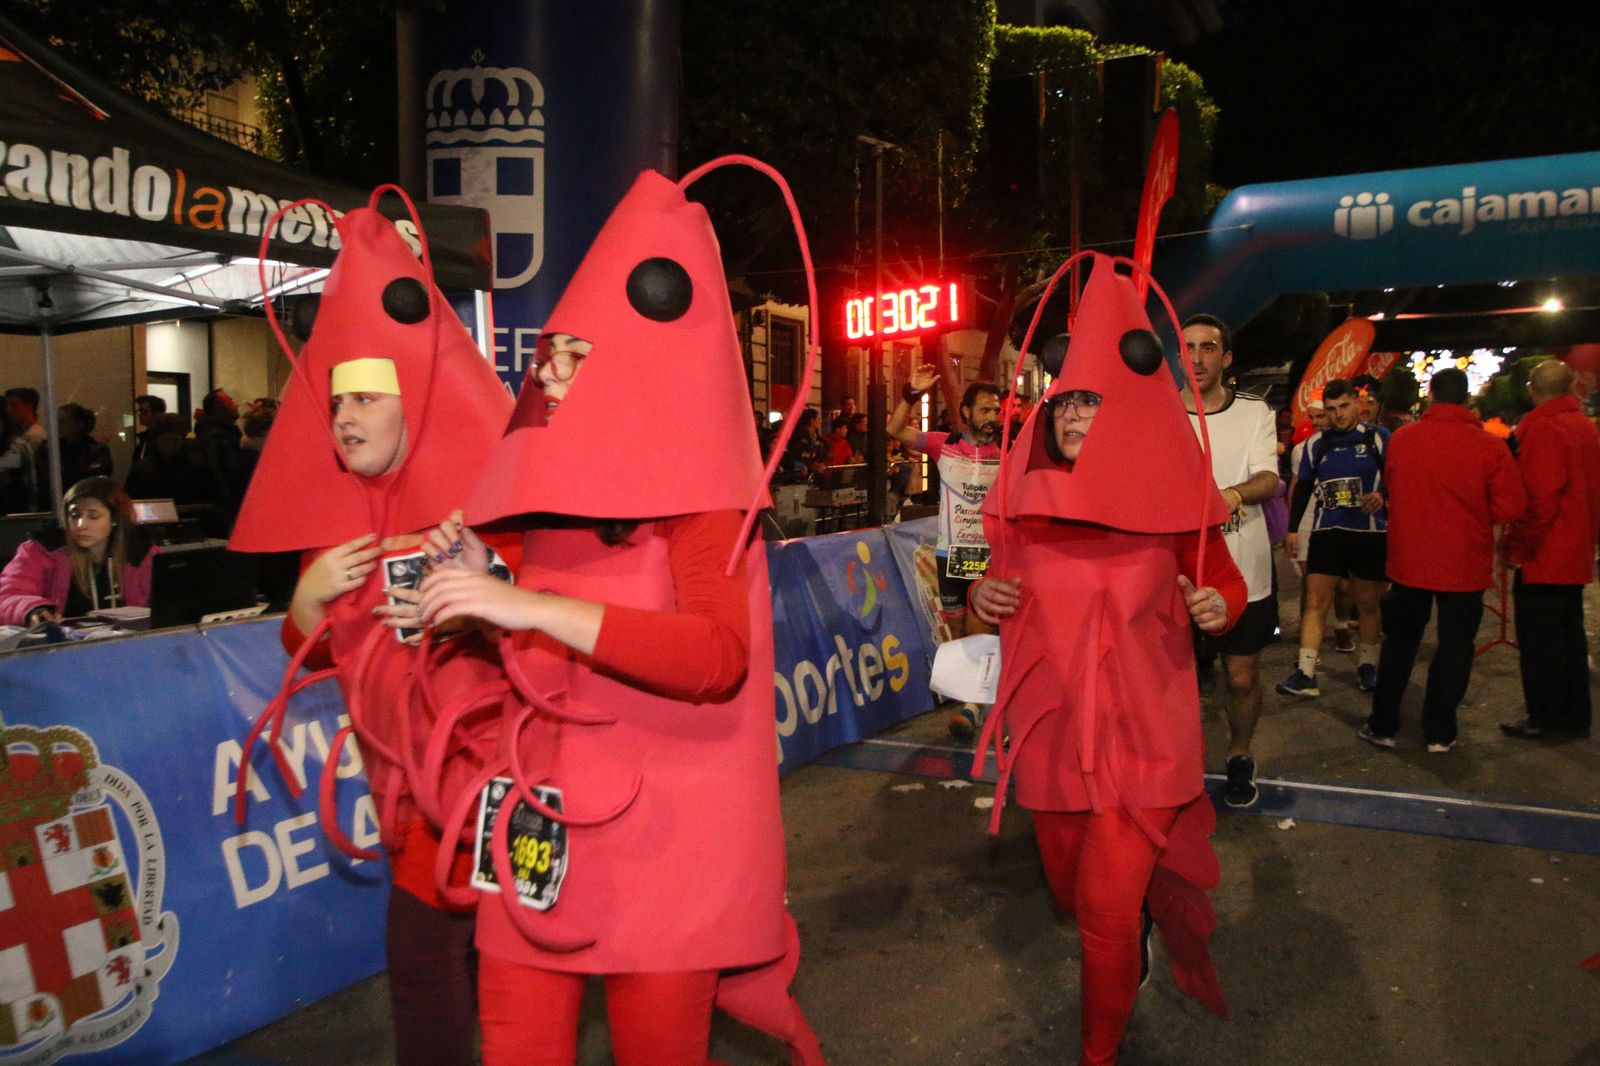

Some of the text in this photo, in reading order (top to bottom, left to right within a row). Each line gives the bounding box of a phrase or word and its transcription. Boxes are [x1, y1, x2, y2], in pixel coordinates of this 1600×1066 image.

[954, 504, 983, 516] Pascua
[212, 713, 364, 816] AYU
[222, 811, 330, 910] DE
